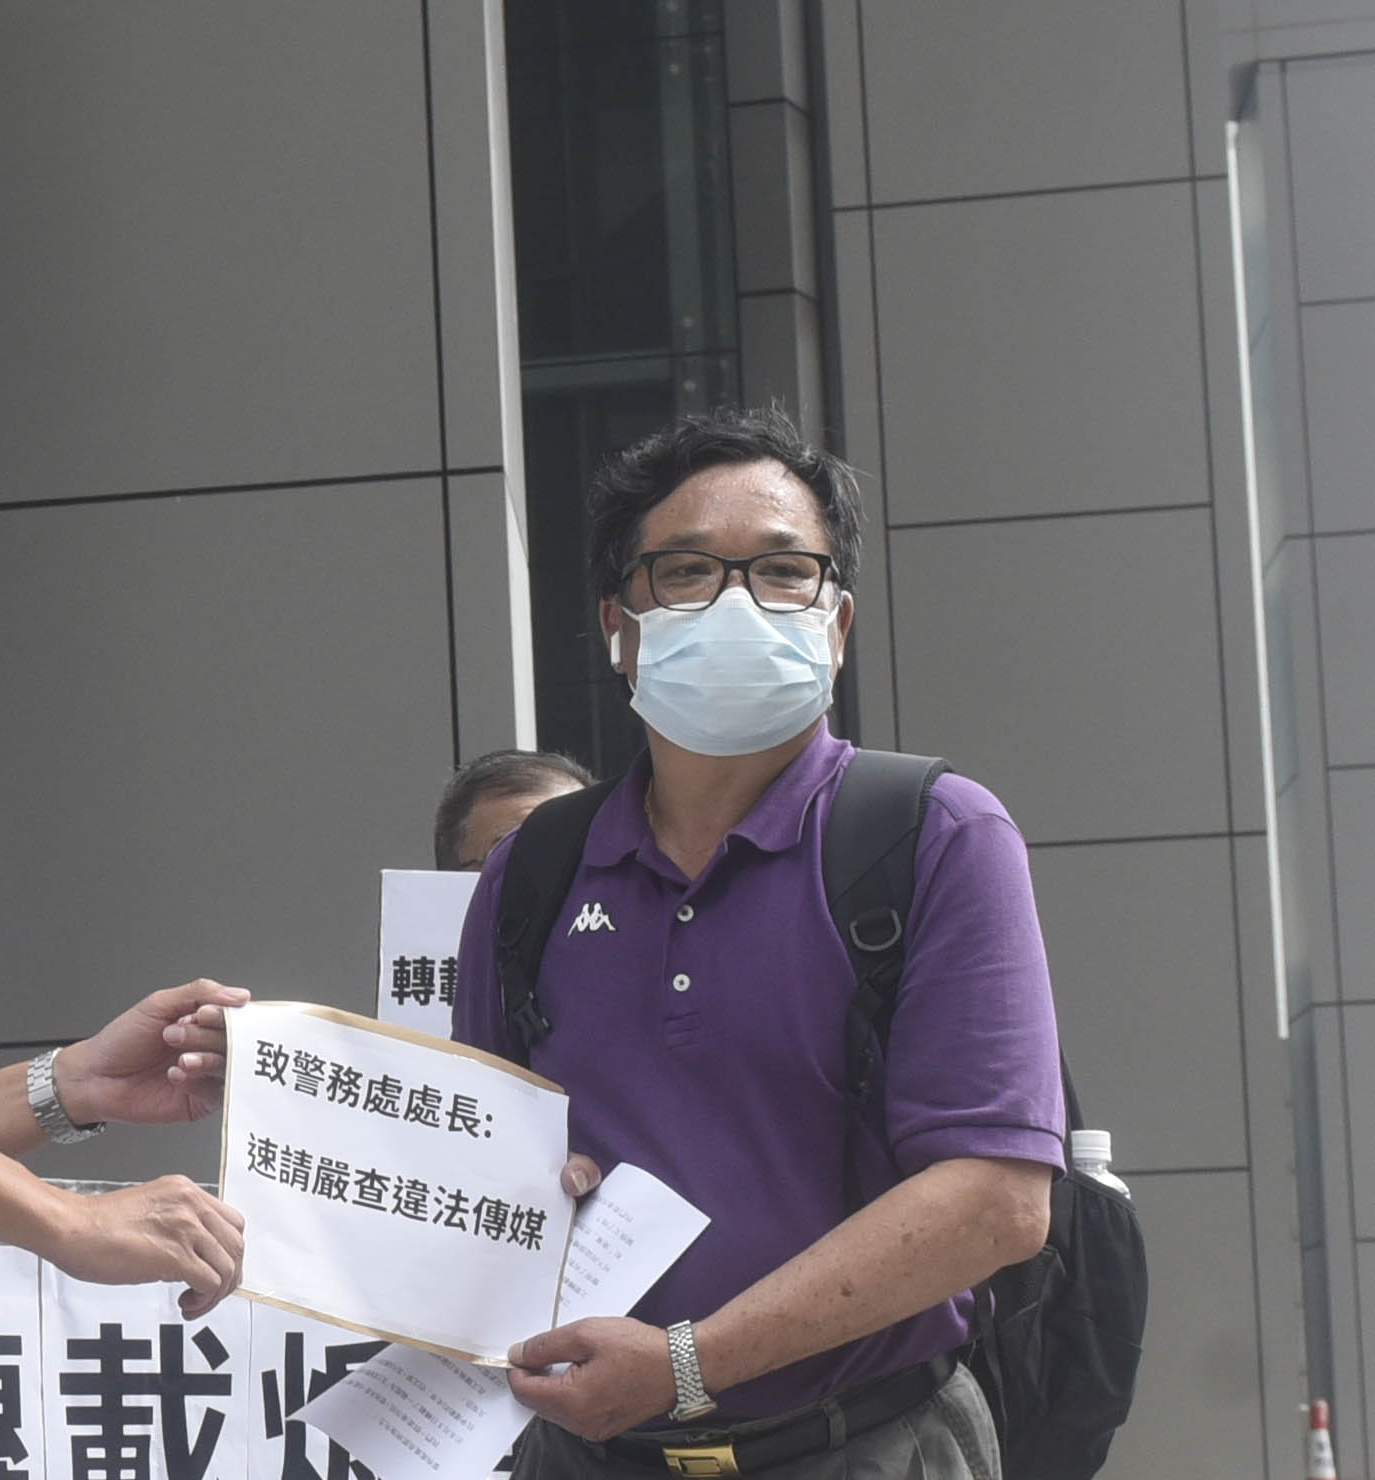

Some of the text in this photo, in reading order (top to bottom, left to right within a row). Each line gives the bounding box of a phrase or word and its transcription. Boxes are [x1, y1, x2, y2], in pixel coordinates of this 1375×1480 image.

[253, 1039, 494, 1140] 致警務處處長:
[246, 1131, 549, 1252] 速請嚴查違法傳媒
